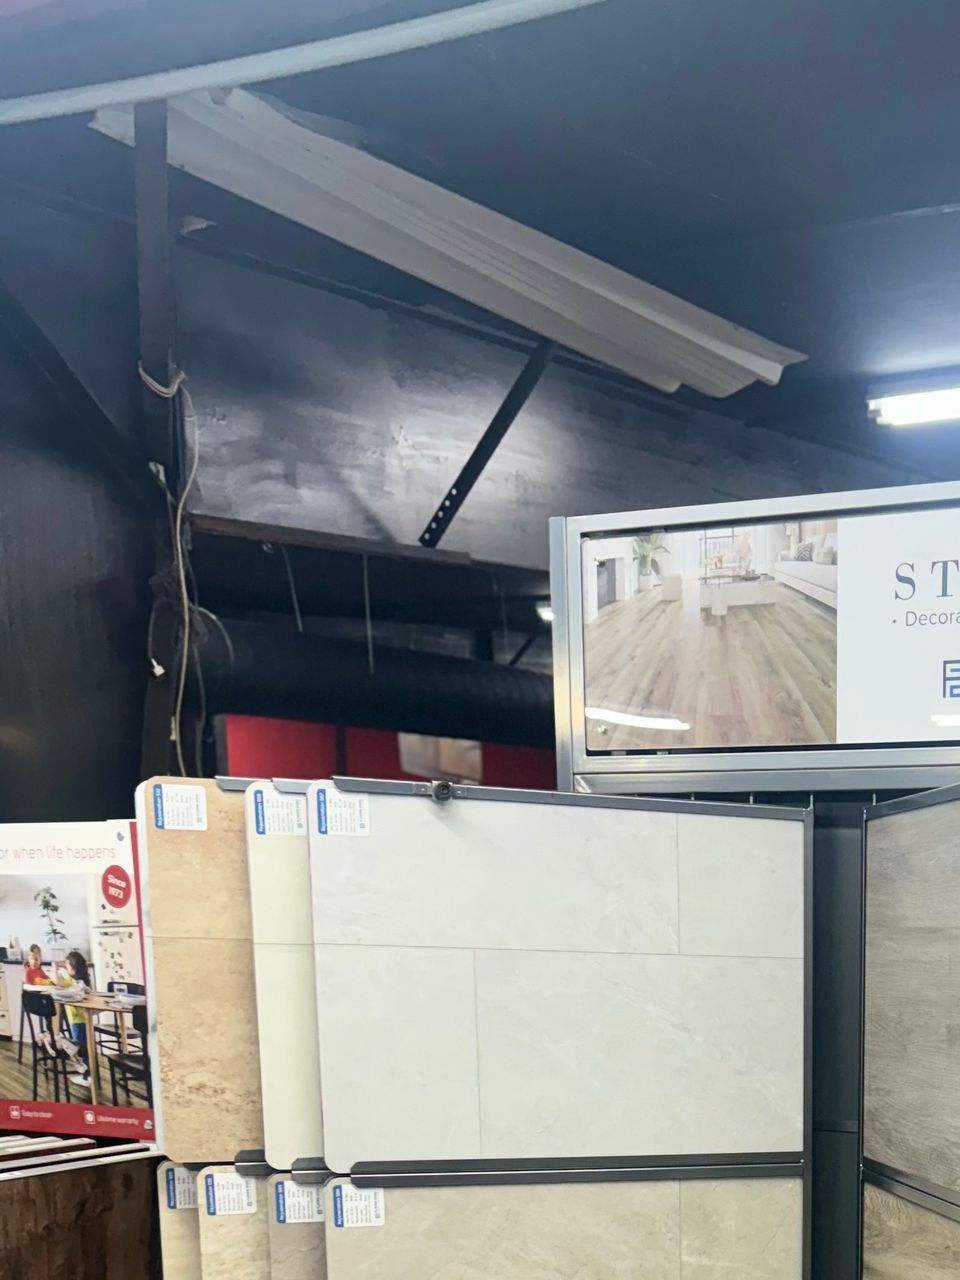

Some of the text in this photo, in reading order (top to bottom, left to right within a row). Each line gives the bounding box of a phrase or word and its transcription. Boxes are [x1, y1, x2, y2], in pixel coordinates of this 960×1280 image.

[14, 845, 44, 859] when
[46, 845, 63, 859] life
[66, 843, 116, 861] happens
[107, 874, 127, 888] Since
[107, 886, 124, 899] 1973
